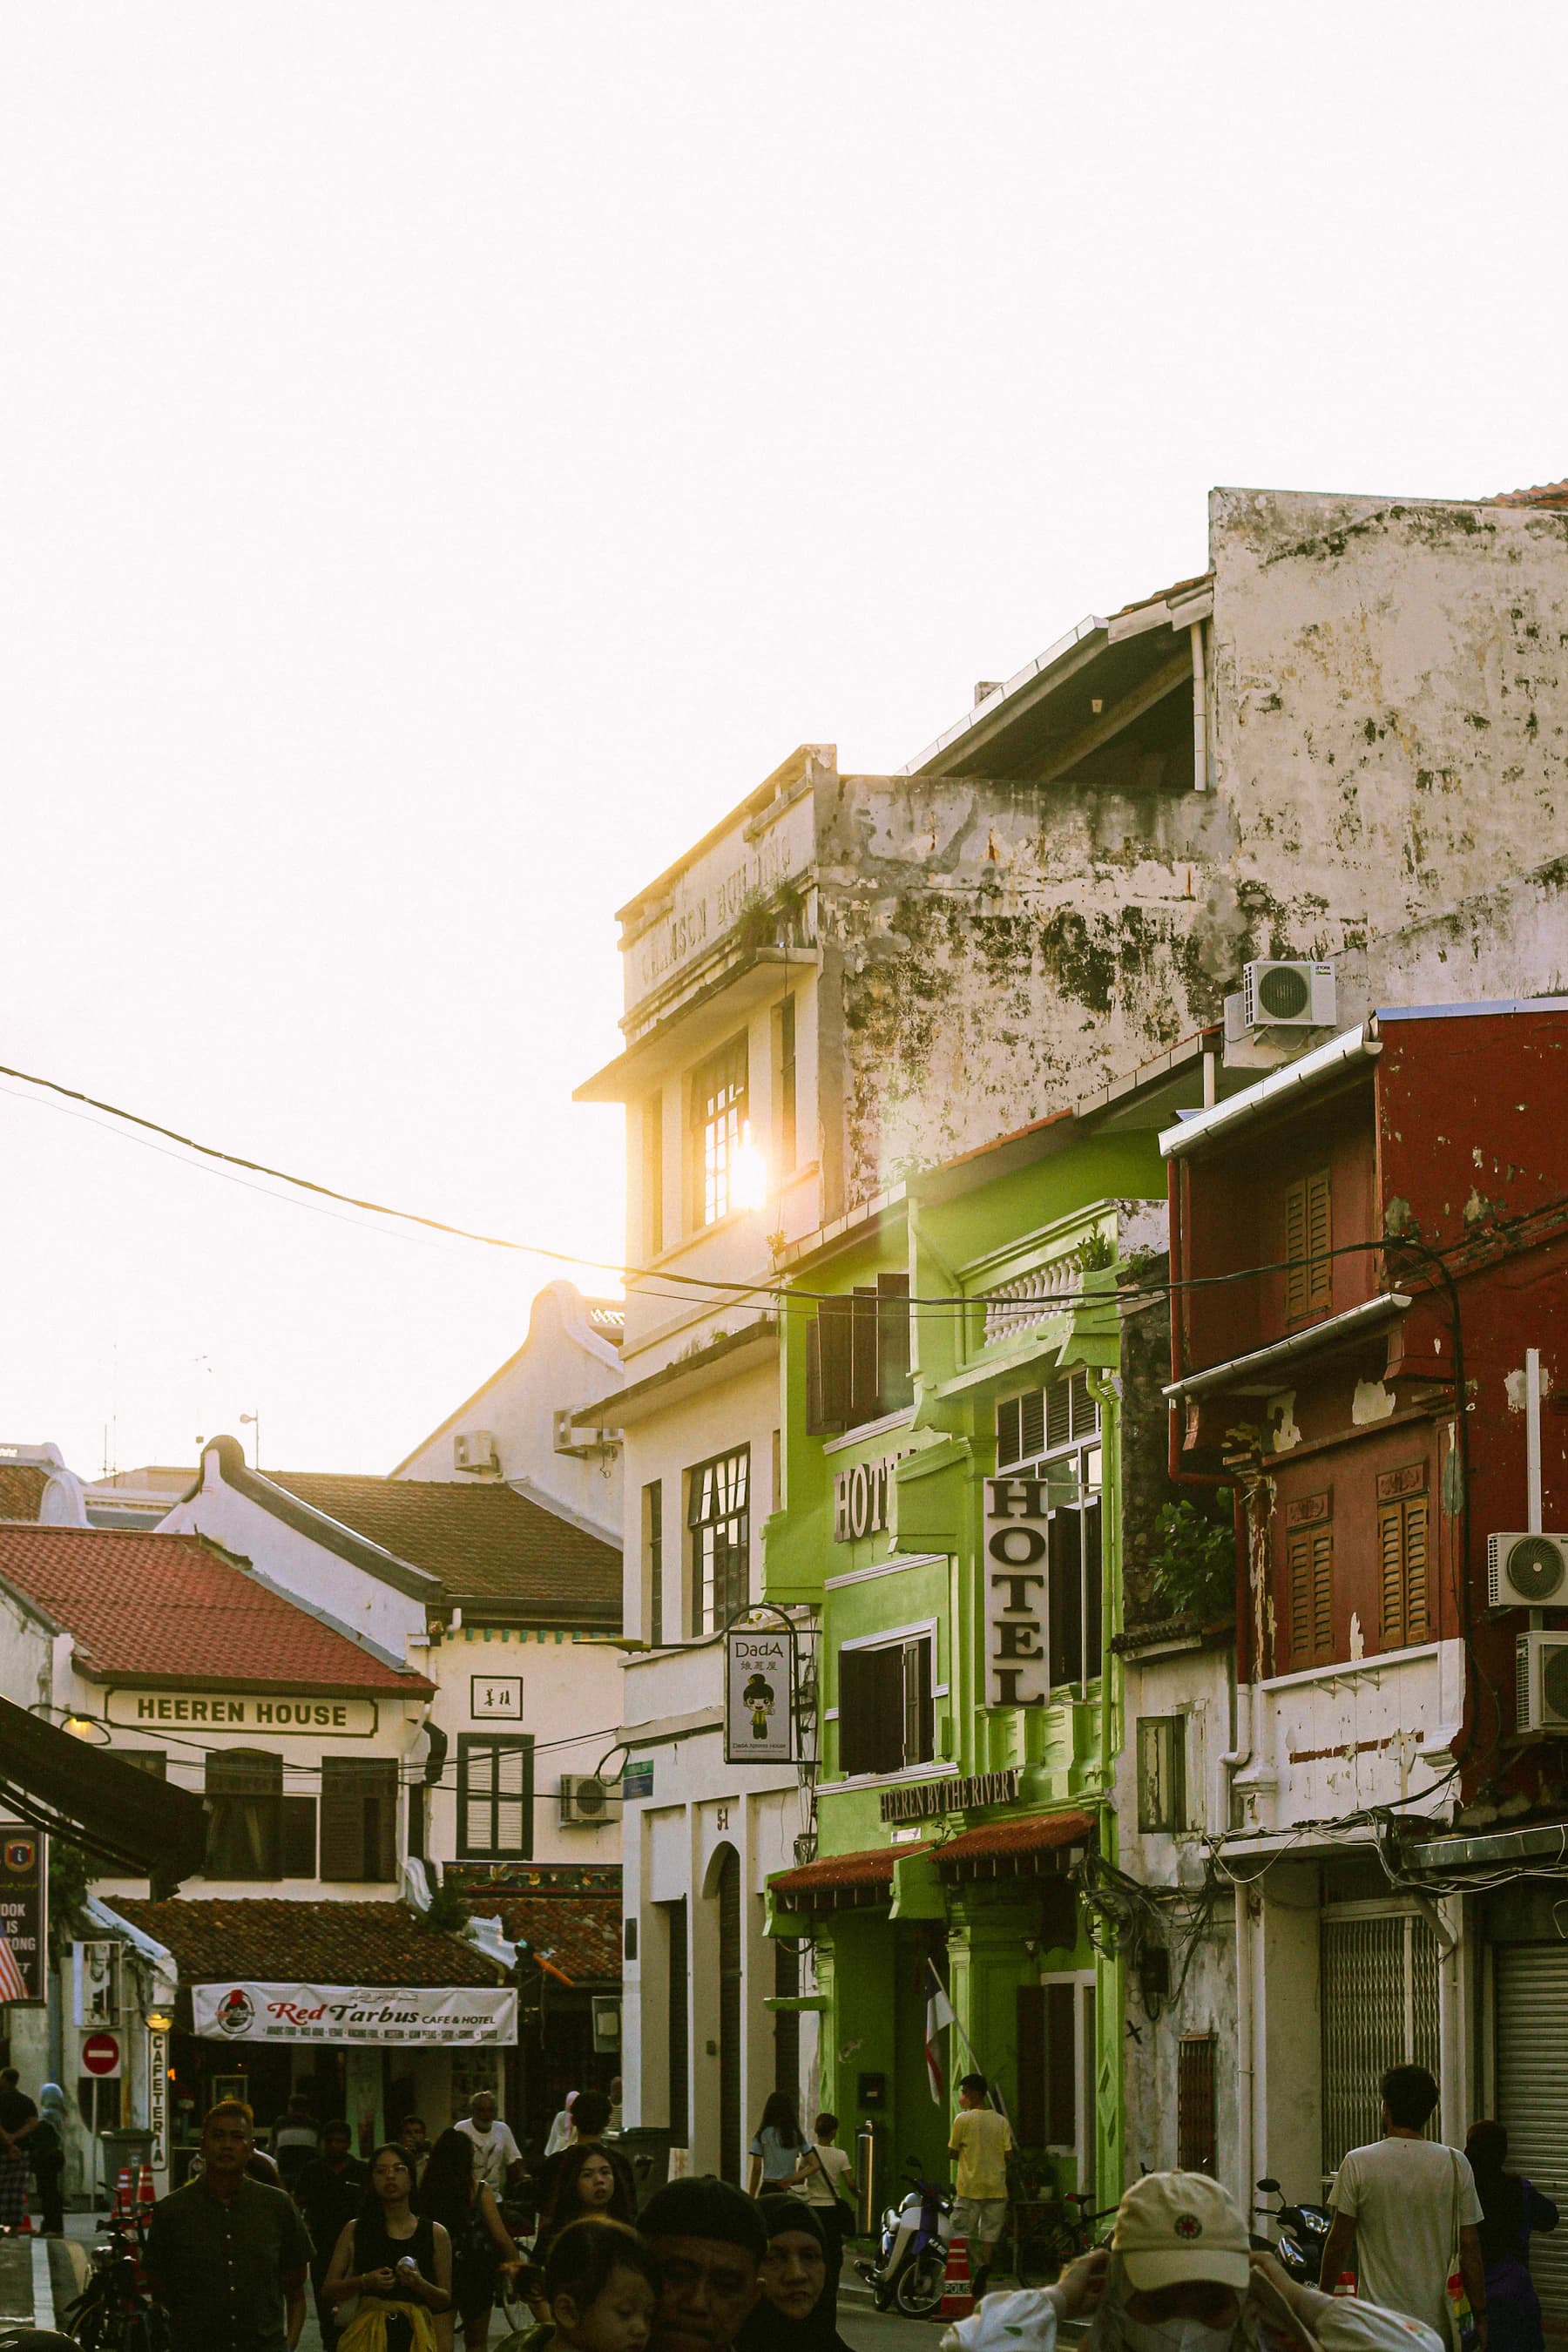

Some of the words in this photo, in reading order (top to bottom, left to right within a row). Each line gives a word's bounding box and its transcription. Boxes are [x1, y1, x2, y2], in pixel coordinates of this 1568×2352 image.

[834, 1450, 915, 1543] HOT
[987, 1480, 1047, 1707] HOTEL
[735, 1642, 783, 1657] DadA
[138, 1699, 244, 1722] HEEREN
[256, 1703, 347, 1727] HOUSE
[880, 1787, 924, 1822] HEEREN
[927, 1782, 941, 1815] BY
[943, 1778, 969, 1812] THE
[971, 1770, 1010, 1807] RIVER
[7, 1936, 36, 1950] ONG
[267, 2003, 327, 2025] Red
[328, 2004, 420, 2023] Tarbus
[462, 2016, 496, 2024] HOTEL
[152, 2035, 164, 2162] CAFETERIA
[945, 2284, 970, 2294] POLIS
